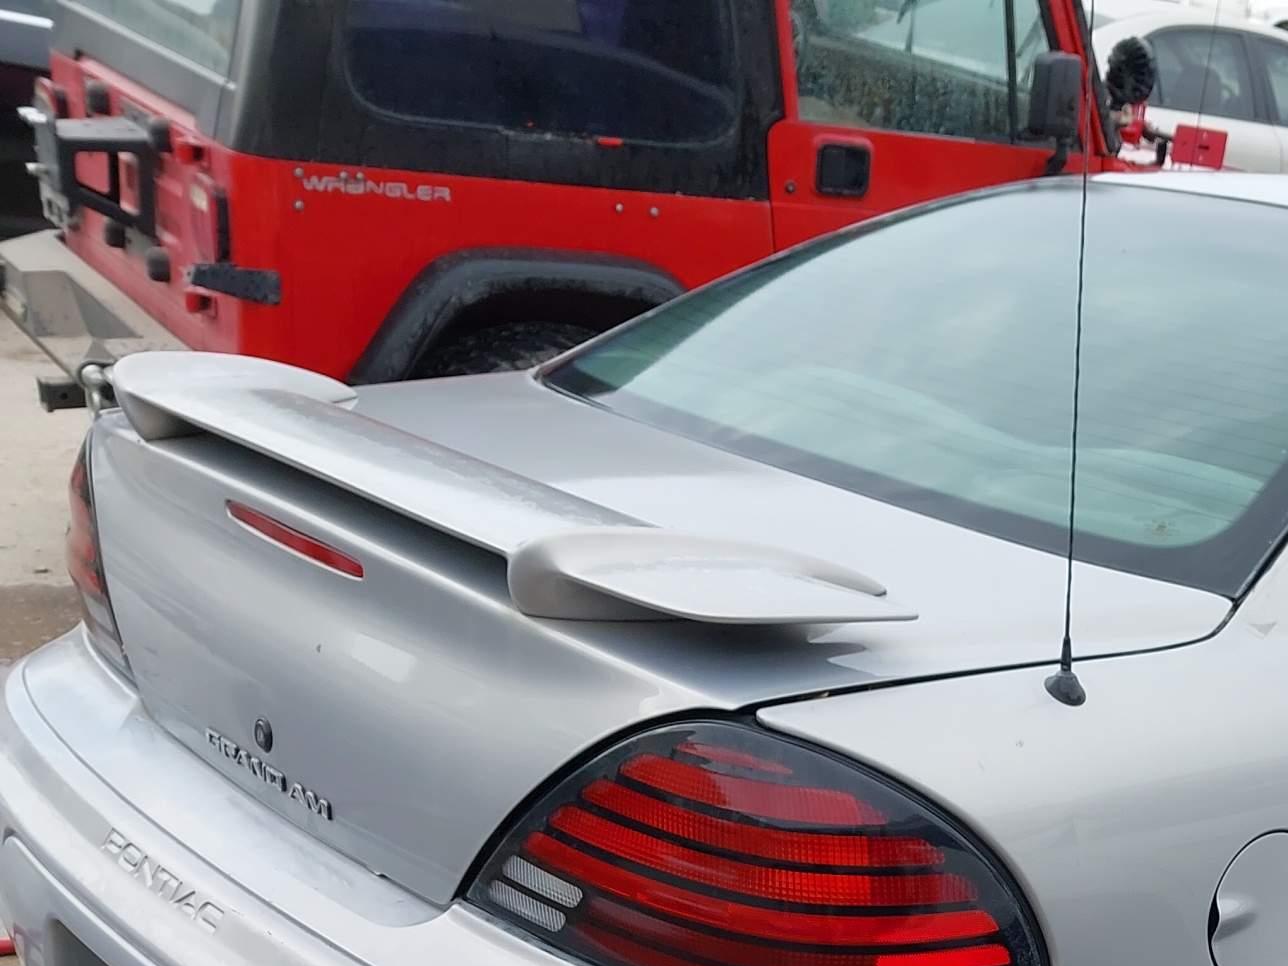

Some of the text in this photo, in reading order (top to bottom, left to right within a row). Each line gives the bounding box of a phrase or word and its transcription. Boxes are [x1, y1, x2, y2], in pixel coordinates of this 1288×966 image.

[205, 727, 334, 821] GRAND AM
[102, 827, 225, 936] PONTIAC
